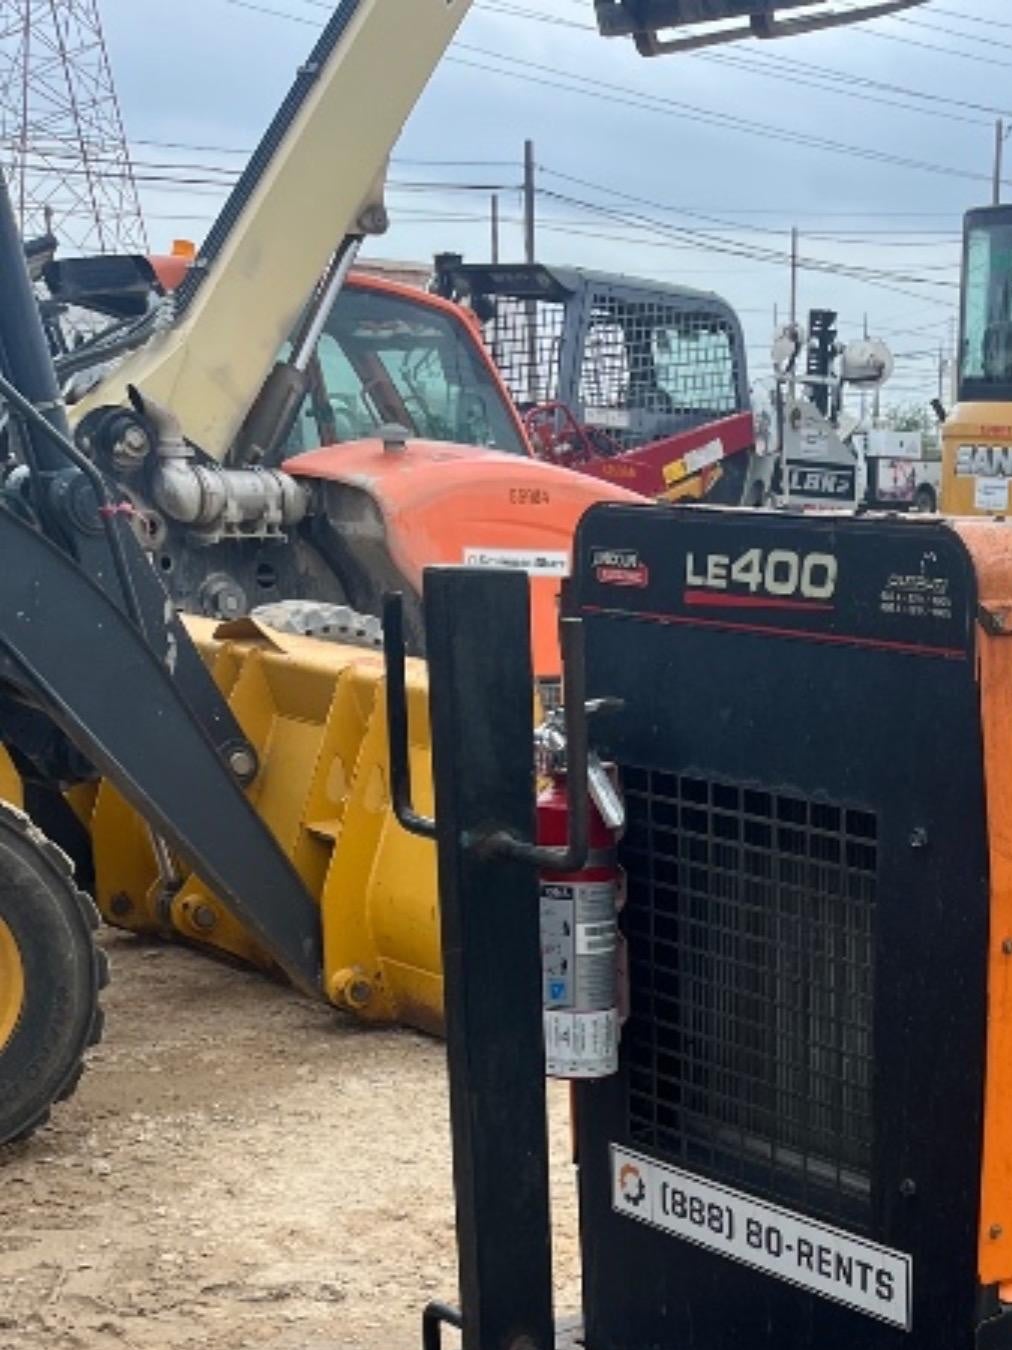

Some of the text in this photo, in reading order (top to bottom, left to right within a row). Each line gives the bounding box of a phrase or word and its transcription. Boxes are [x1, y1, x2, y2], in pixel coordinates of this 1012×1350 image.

[685, 548, 839, 599] LE400
[660, 1181, 896, 1303] (888) 80-RENTS
